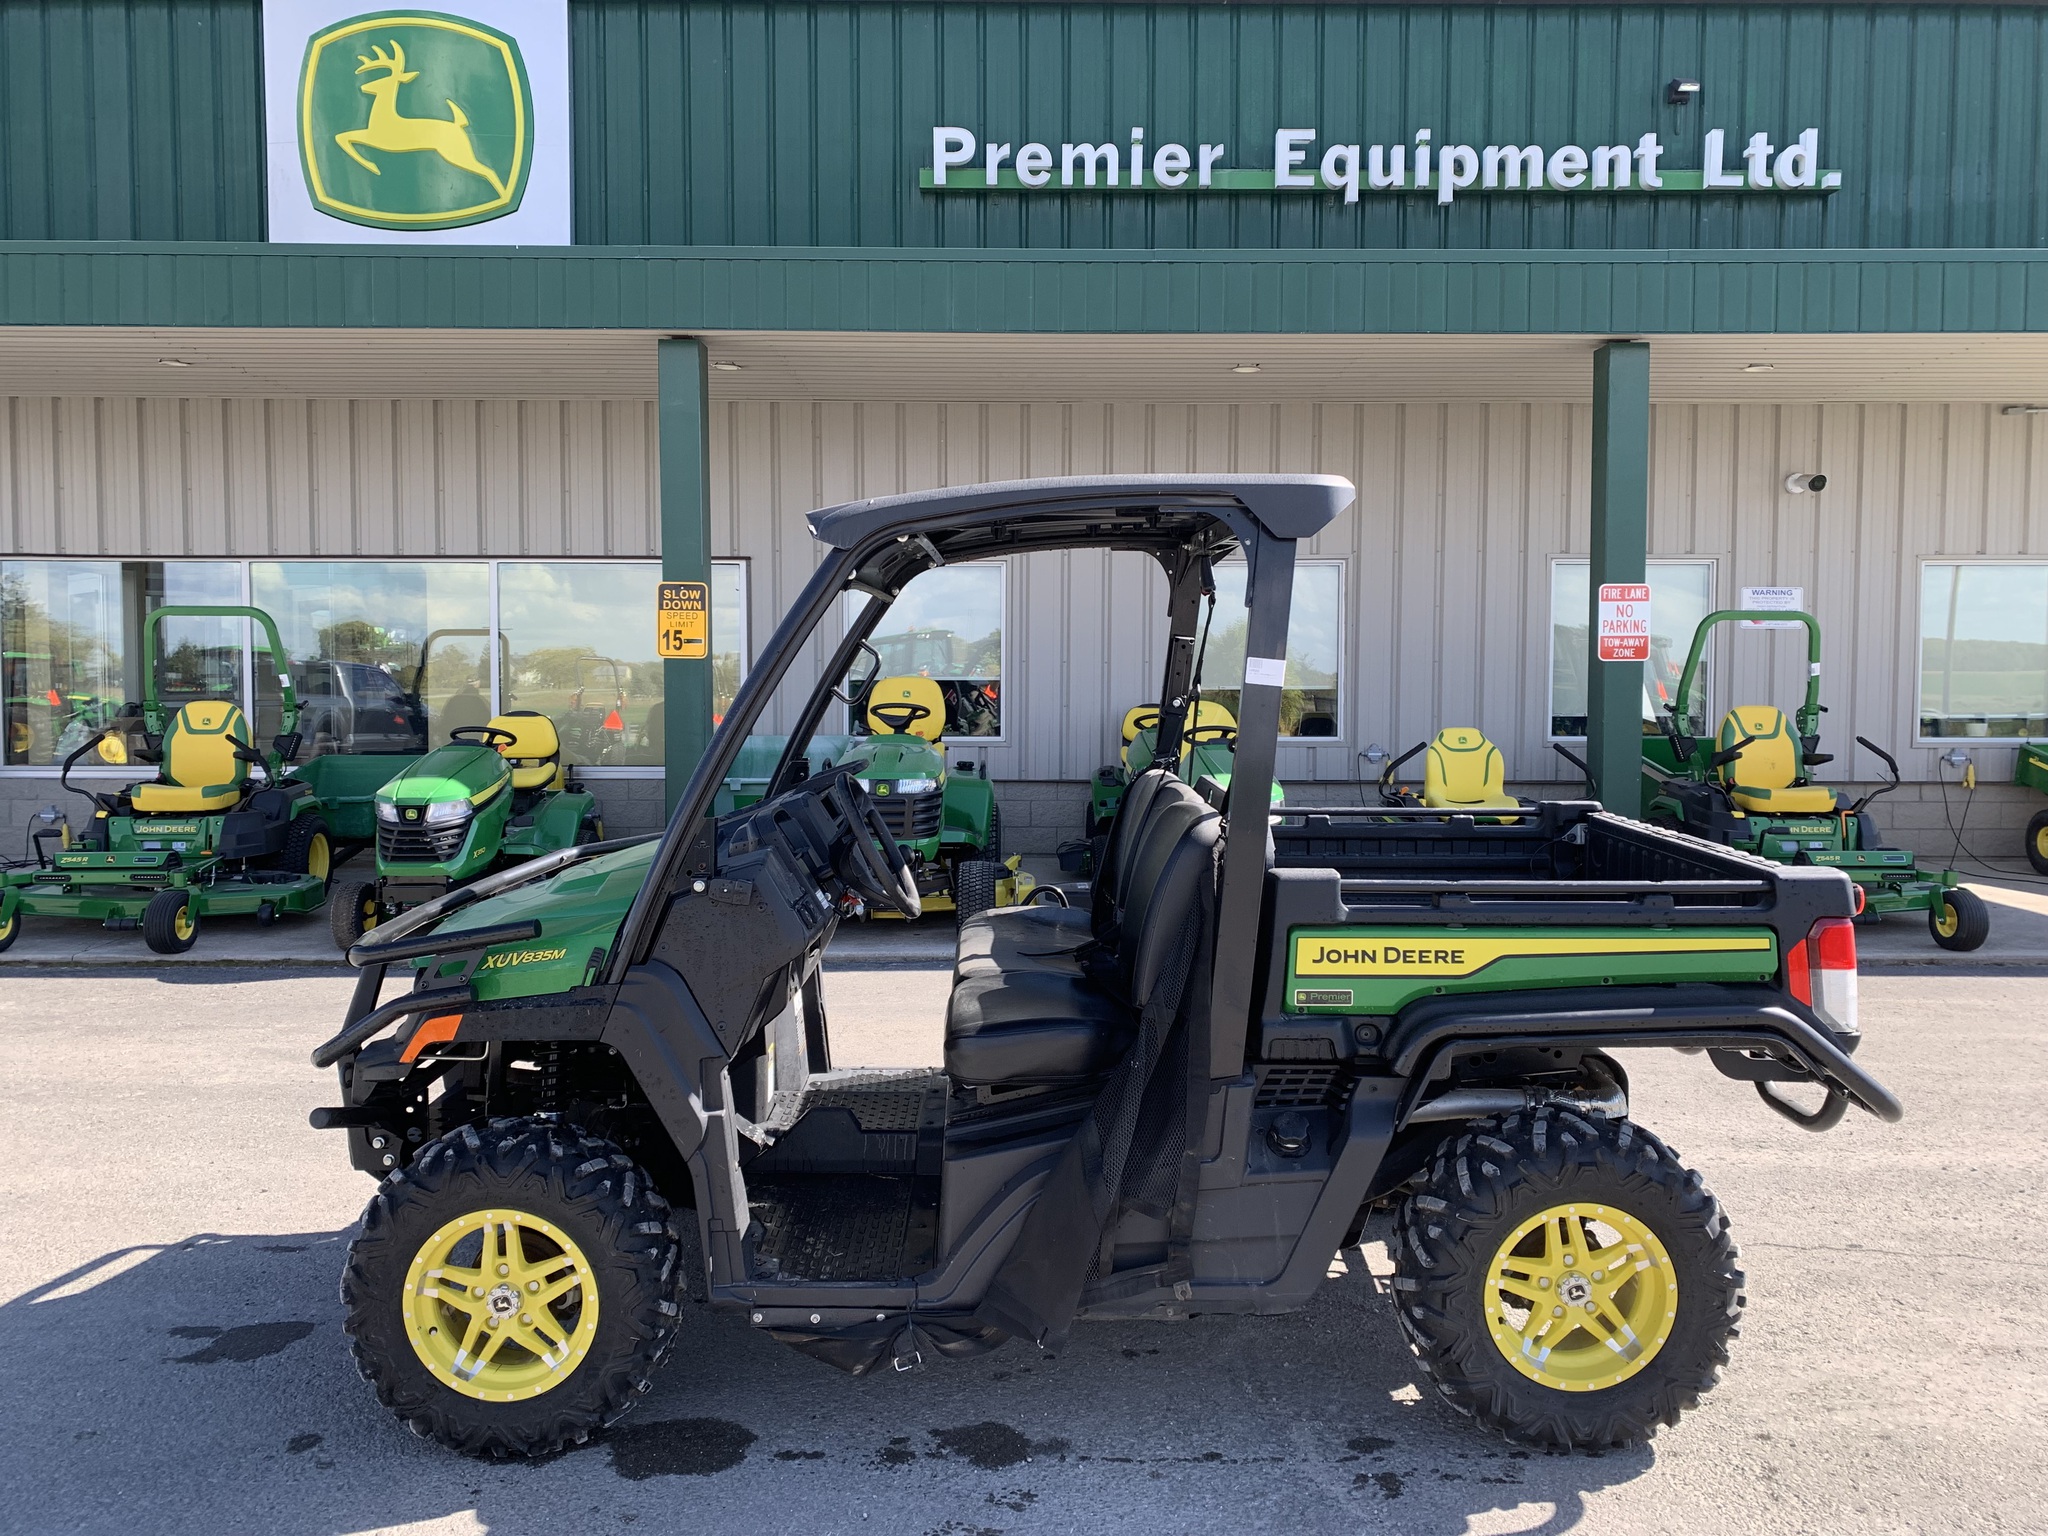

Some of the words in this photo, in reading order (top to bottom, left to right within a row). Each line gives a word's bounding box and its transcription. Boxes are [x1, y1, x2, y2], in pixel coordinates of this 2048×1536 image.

[932, 126, 1224, 189] Premier
[1274, 128, 1663, 206] Equipment
[1703, 127, 1842, 190] Ltd.
[663, 589, 701, 600] SLOW
[1603, 588, 1622, 599] FIRE
[1625, 588, 1647, 599] LANE
[662, 600, 702, 610] DOWN
[666, 611, 699, 620] SPEED
[1616, 604, 1634, 618] NO
[1602, 619, 1647, 634] PARKING
[662, 629, 683, 651] 15
[1604, 638, 1646, 647] TOW-AWAY
[1613, 648, 1636, 658] ZONE
[136, 825, 163, 833] JOHN
[164, 825, 197, 833] DEERE
[1801, 825, 1832, 833] DEERE
[481, 948, 567, 970] XUV835M
[1312, 946, 1377, 964] JOHN
[1384, 946, 1465, 964] DEERE
[1310, 992, 1351, 1001] Premier
